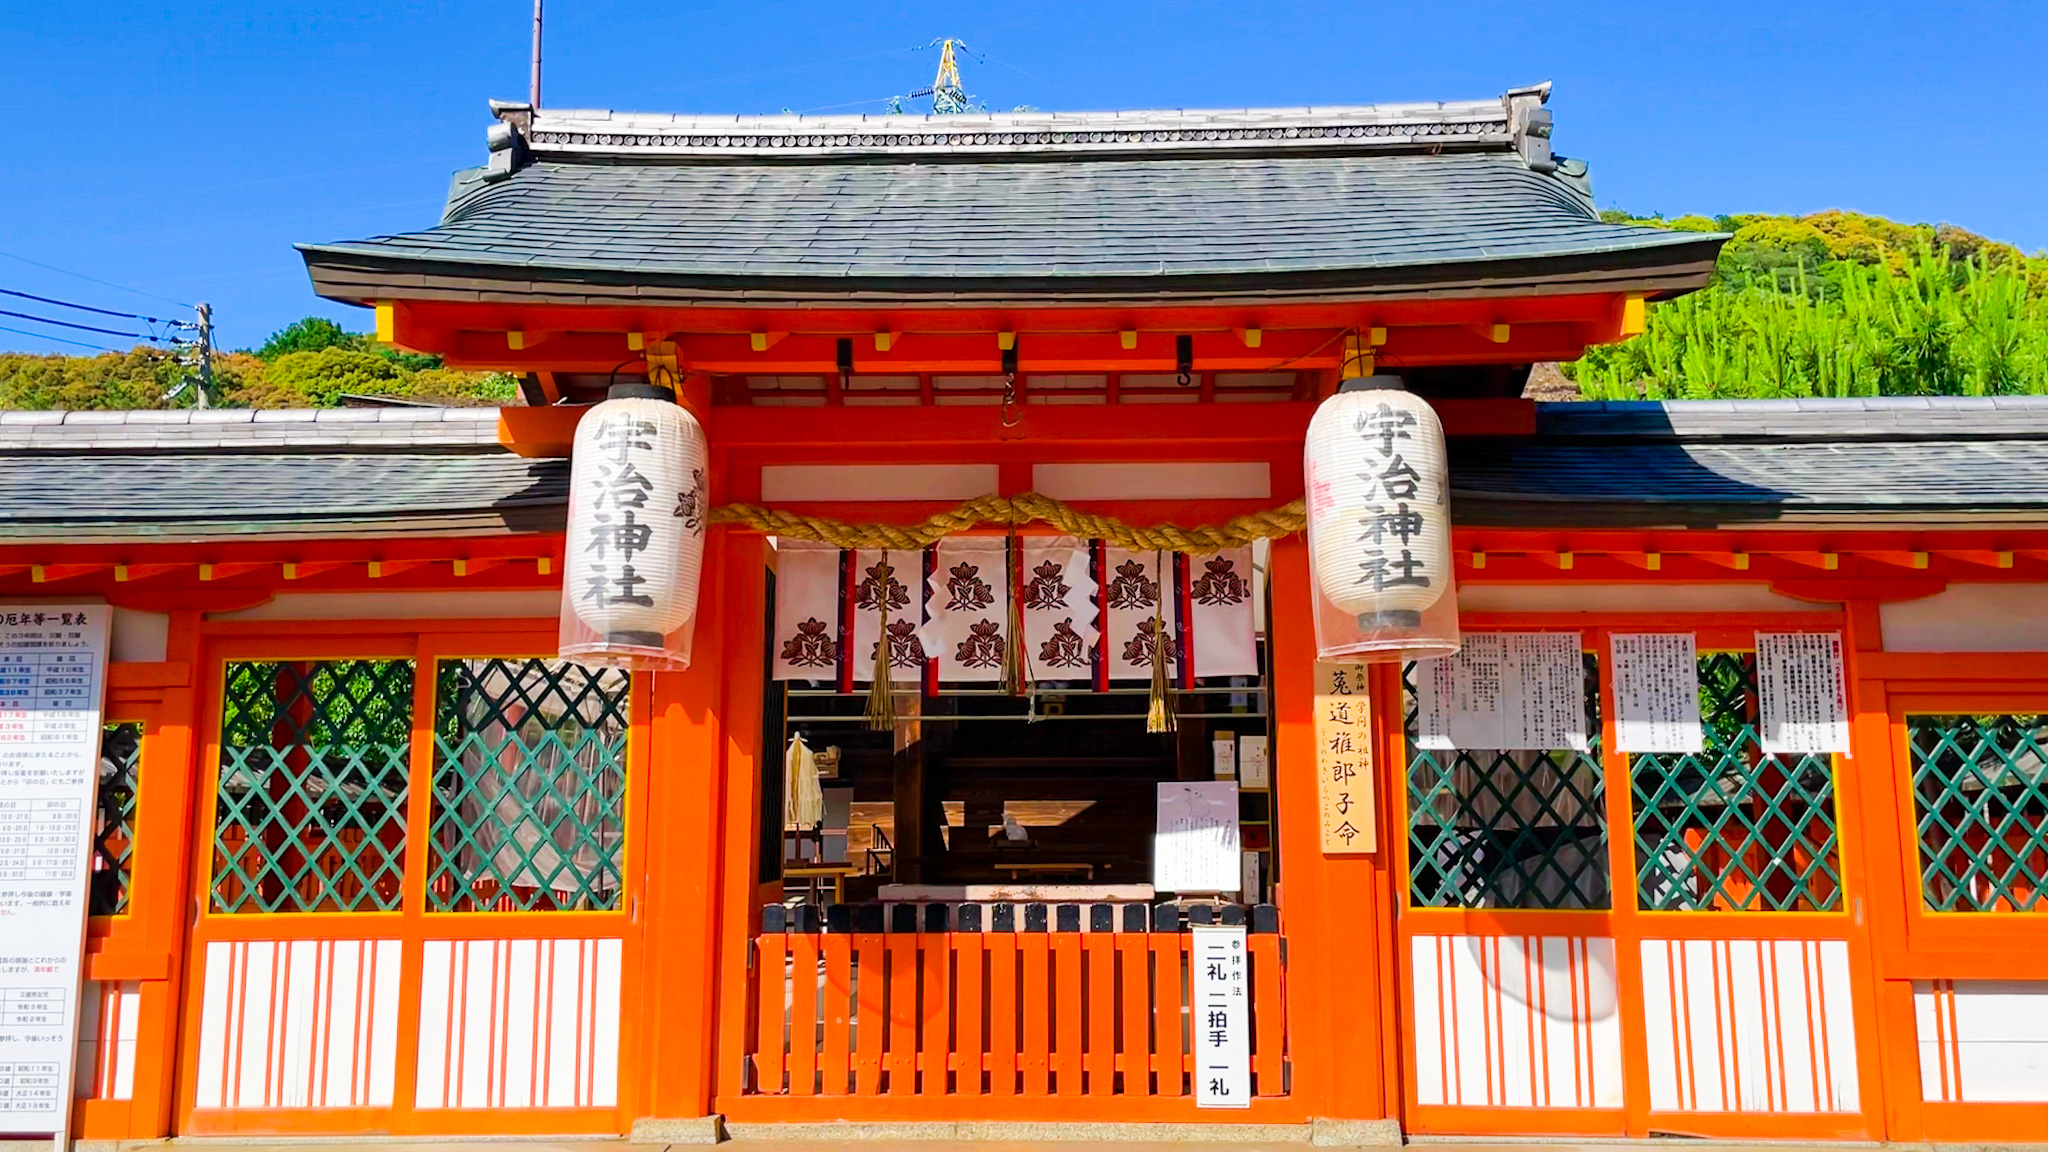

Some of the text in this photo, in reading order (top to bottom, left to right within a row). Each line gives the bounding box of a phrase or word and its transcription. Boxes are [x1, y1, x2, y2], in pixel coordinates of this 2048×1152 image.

[581, 412, 658, 610] 宇治神社
[1353, 403, 1431, 592] 宇治神社
[1354, 664, 1365, 691] 御祭神
[1355, 700, 1370, 771] 学問の祖神
[1206, 946, 1230, 1096] 二礼 二拍手 一礼
